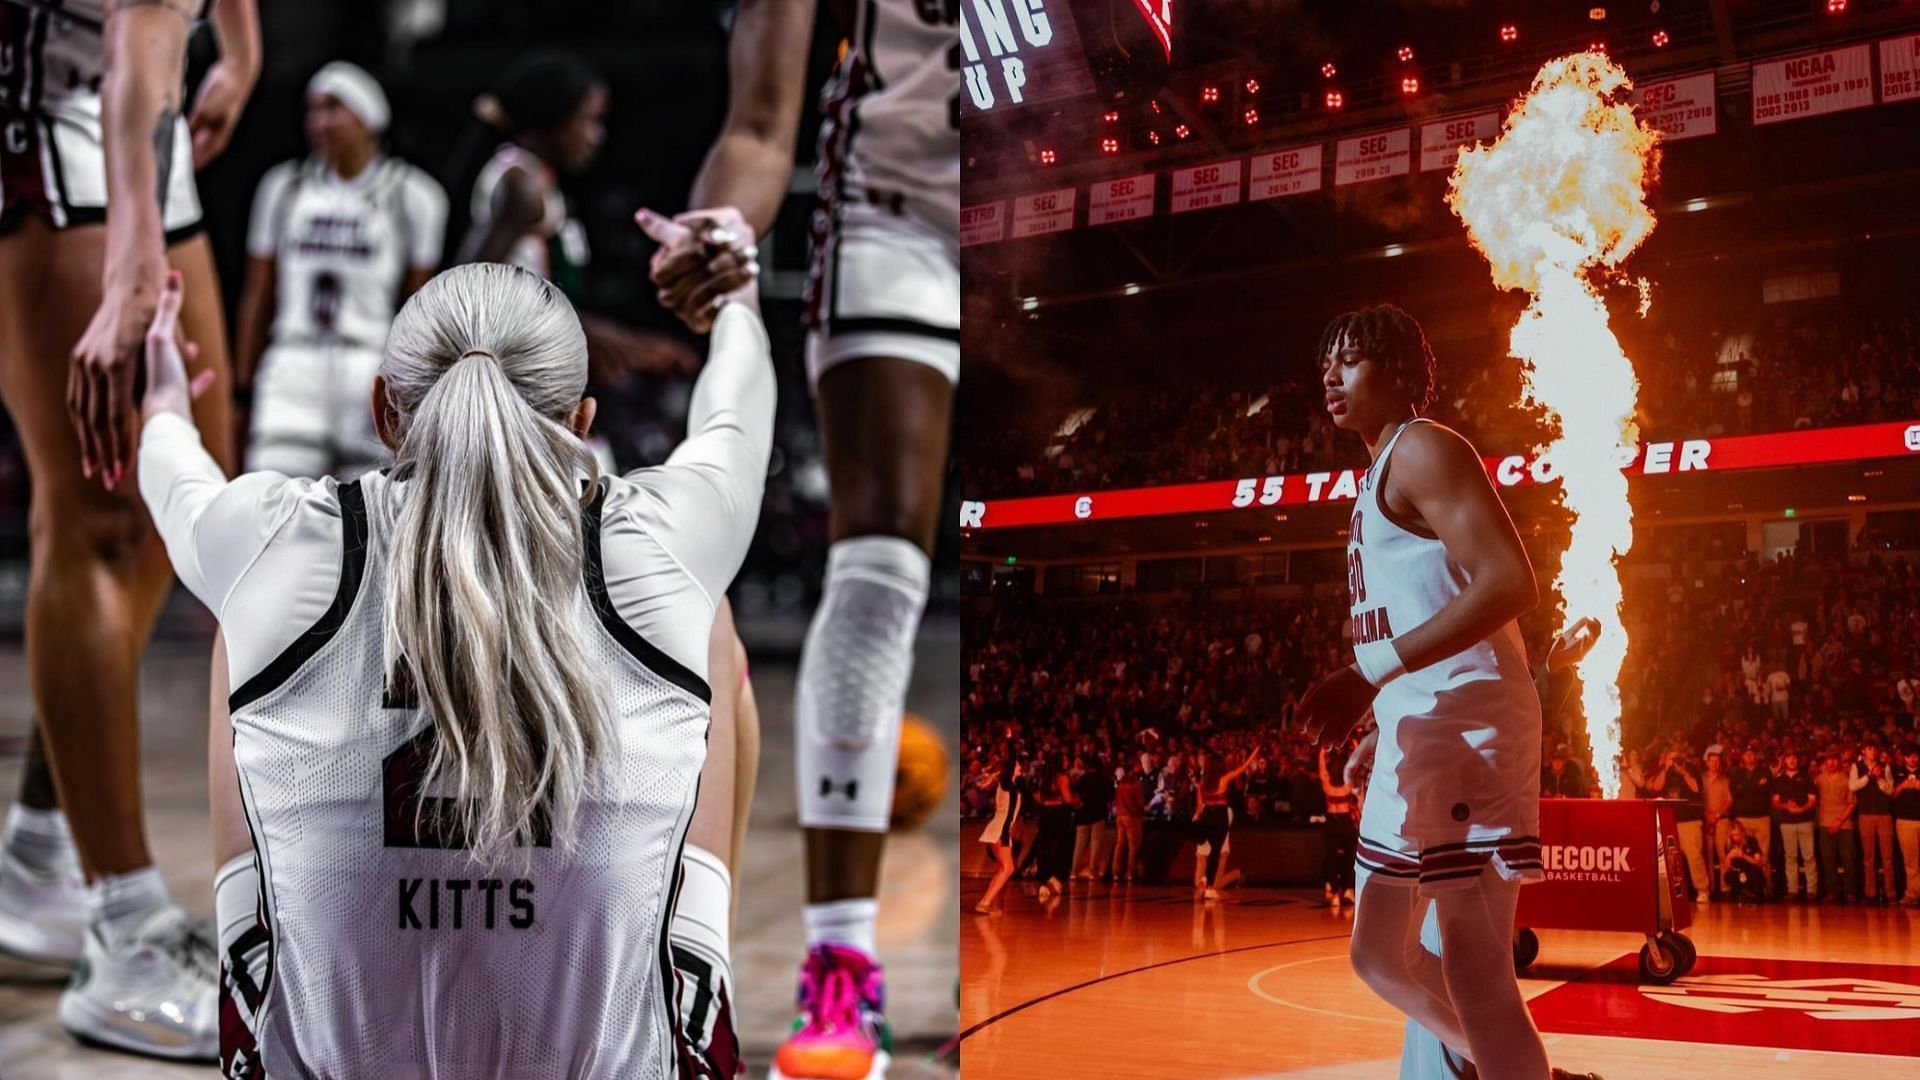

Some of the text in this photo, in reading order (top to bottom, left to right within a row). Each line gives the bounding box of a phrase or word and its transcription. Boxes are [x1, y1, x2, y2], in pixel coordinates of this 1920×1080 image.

[1785, 54, 1836, 80] NCAA
[964, 57, 1027, 110] UP
[1784, 89, 1809, 102] 1988
[1814, 82, 1840, 97] 1989
[1844, 77, 1870, 91] 1991
[1884, 80, 1912, 97] 2016
[1755, 100, 1810, 119] 2003 2013
[1446, 121, 1476, 140] SEC
[1359, 136, 1388, 156] SEC
[1272, 152, 1300, 172] SEC
[1193, 167, 1220, 186] SEC
[1110, 180, 1135, 198] SEC
[1032, 195, 1057, 212] SEC
[1232, 476, 1285, 508] 55
[1547, 871, 1621, 883] BASKETBALL
[398, 878, 536, 931] KITTS
